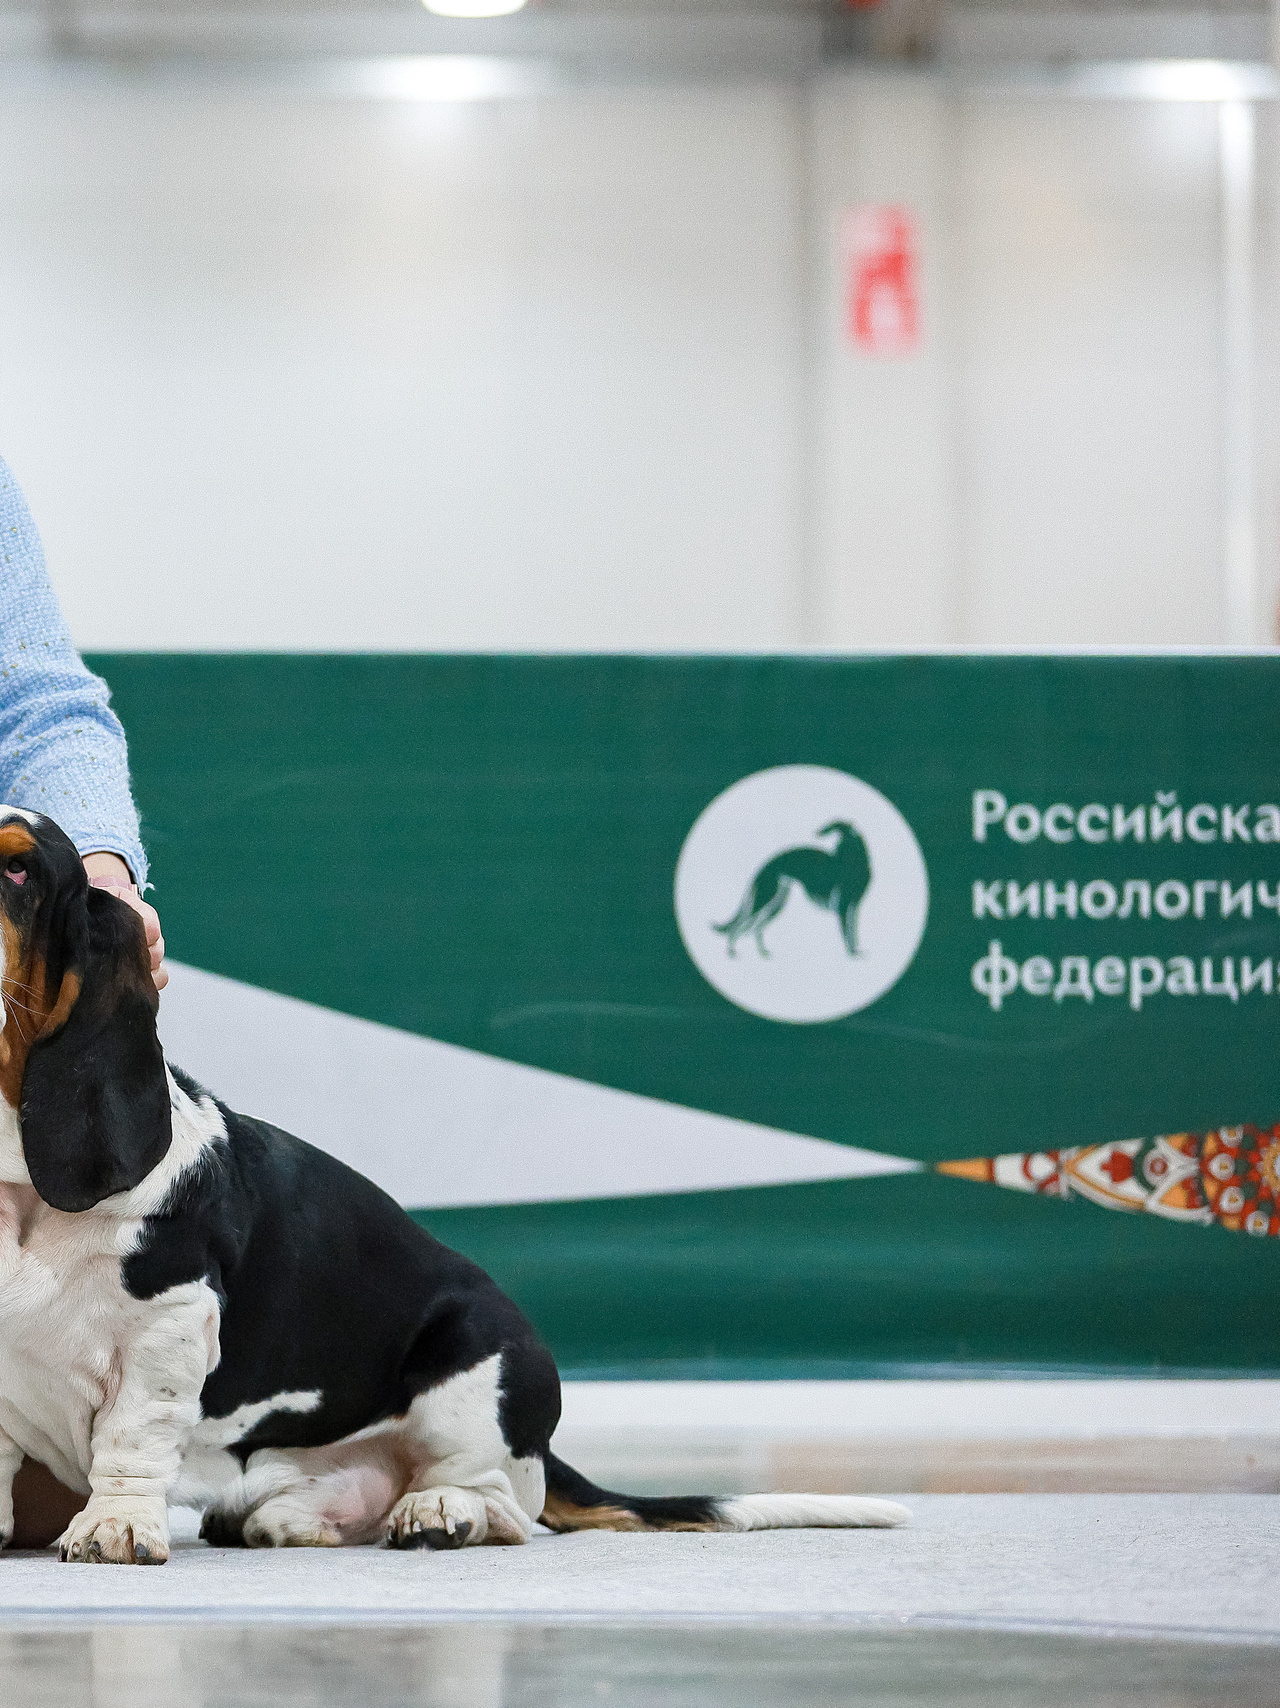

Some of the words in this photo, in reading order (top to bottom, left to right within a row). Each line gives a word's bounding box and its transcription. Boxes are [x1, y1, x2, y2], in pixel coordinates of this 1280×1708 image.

[972, 788, 1280, 844] Российска
[972, 878, 1280, 920] кинологич
[971, 938, 1280, 1012] федераци
